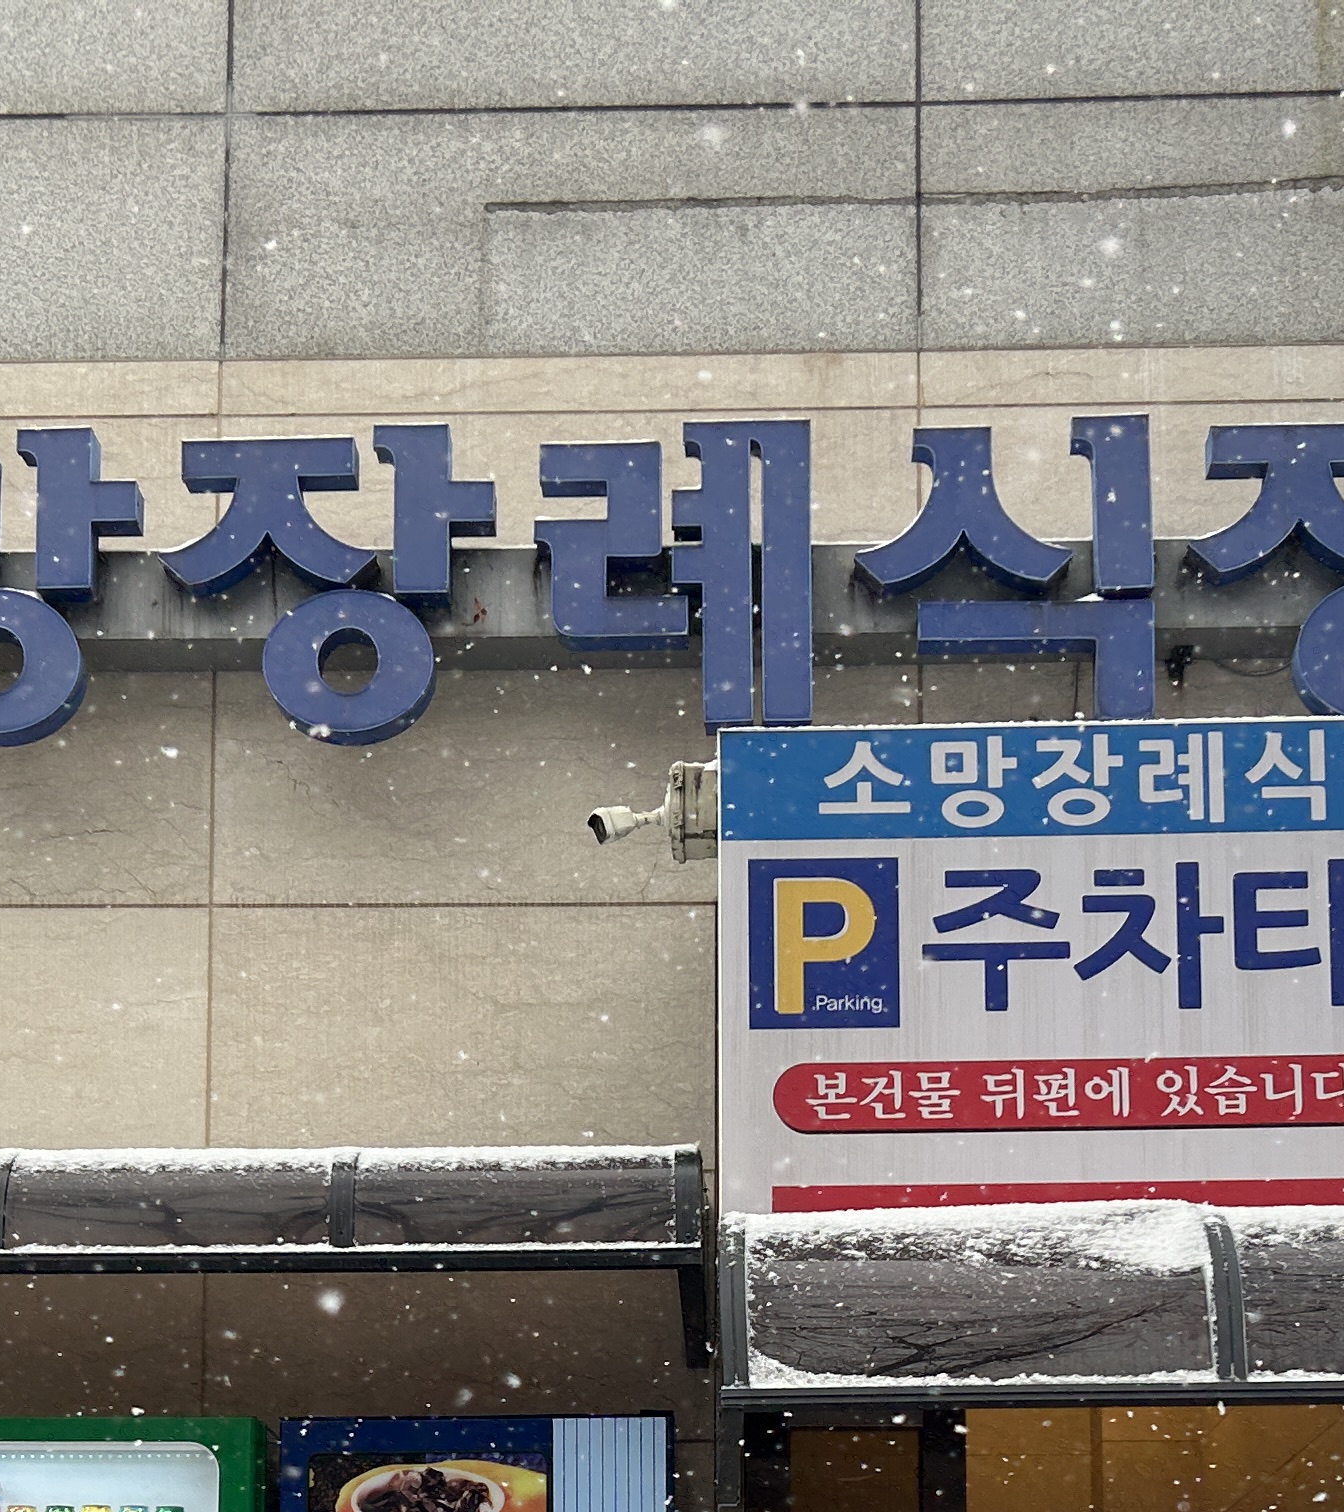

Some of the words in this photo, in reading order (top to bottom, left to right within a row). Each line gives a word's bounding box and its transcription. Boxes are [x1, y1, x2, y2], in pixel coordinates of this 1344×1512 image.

[774, 876, 877, 1016] P
[814, 994, 884, 1014] Parking
[804, 1071, 965, 1122] 본건물
[981, 1064, 1132, 1118] 뒤편에
